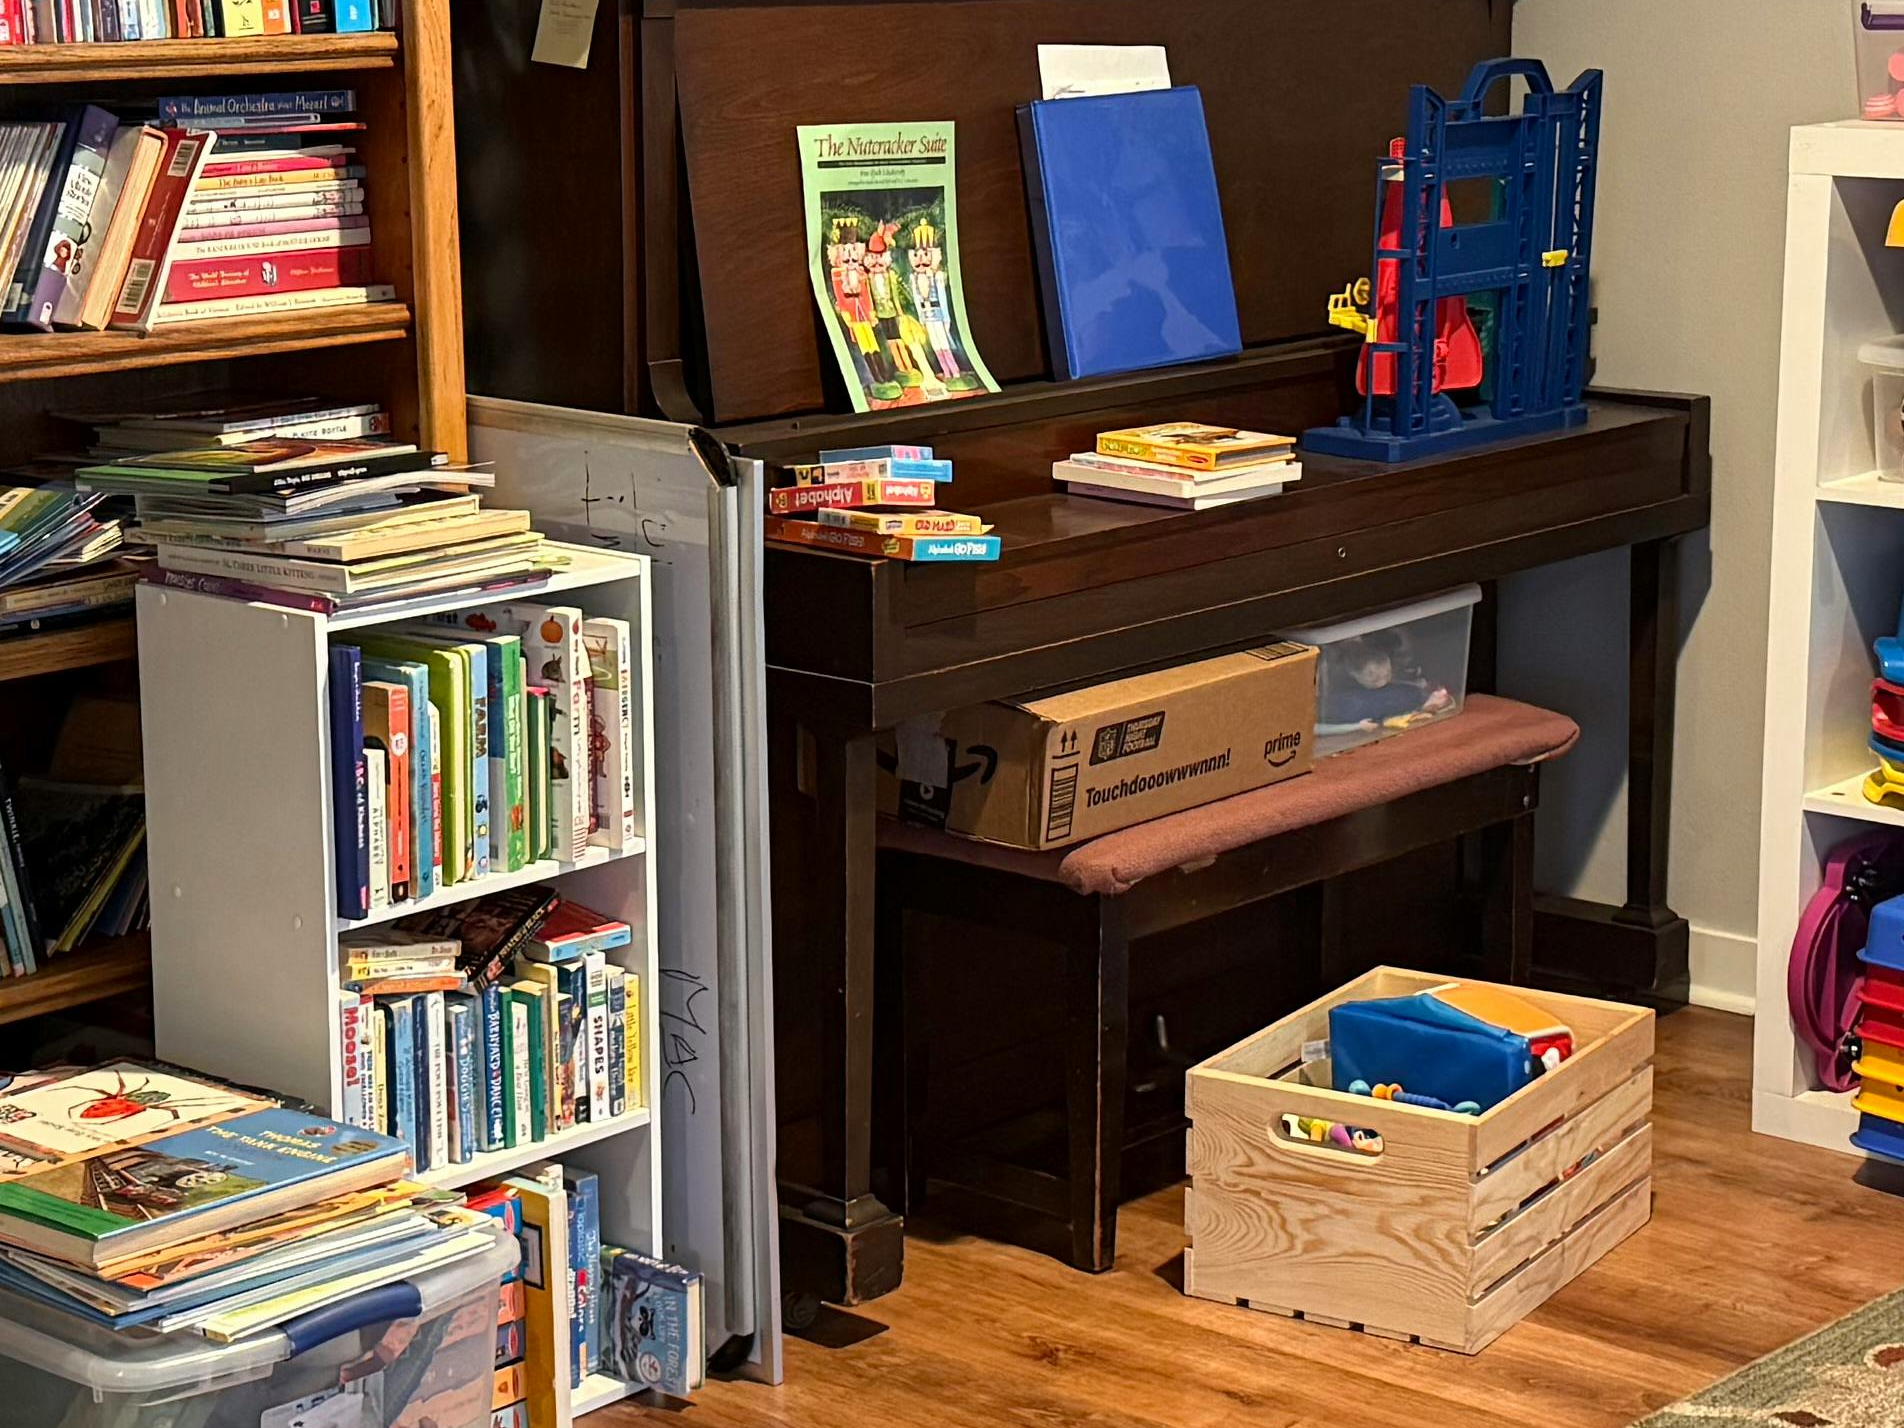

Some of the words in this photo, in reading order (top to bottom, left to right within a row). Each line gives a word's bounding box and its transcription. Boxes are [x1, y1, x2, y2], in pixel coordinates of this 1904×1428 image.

[814, 134, 845, 157] The
[846, 131, 918, 156] Nutcracker
[918, 132, 947, 155] Suite
[795, 486, 853, 508] Alphabet
[1263, 730, 1301, 759] prime
[593, 1015, 605, 1075] SHAPES
[666, 1315, 680, 1340] THE
